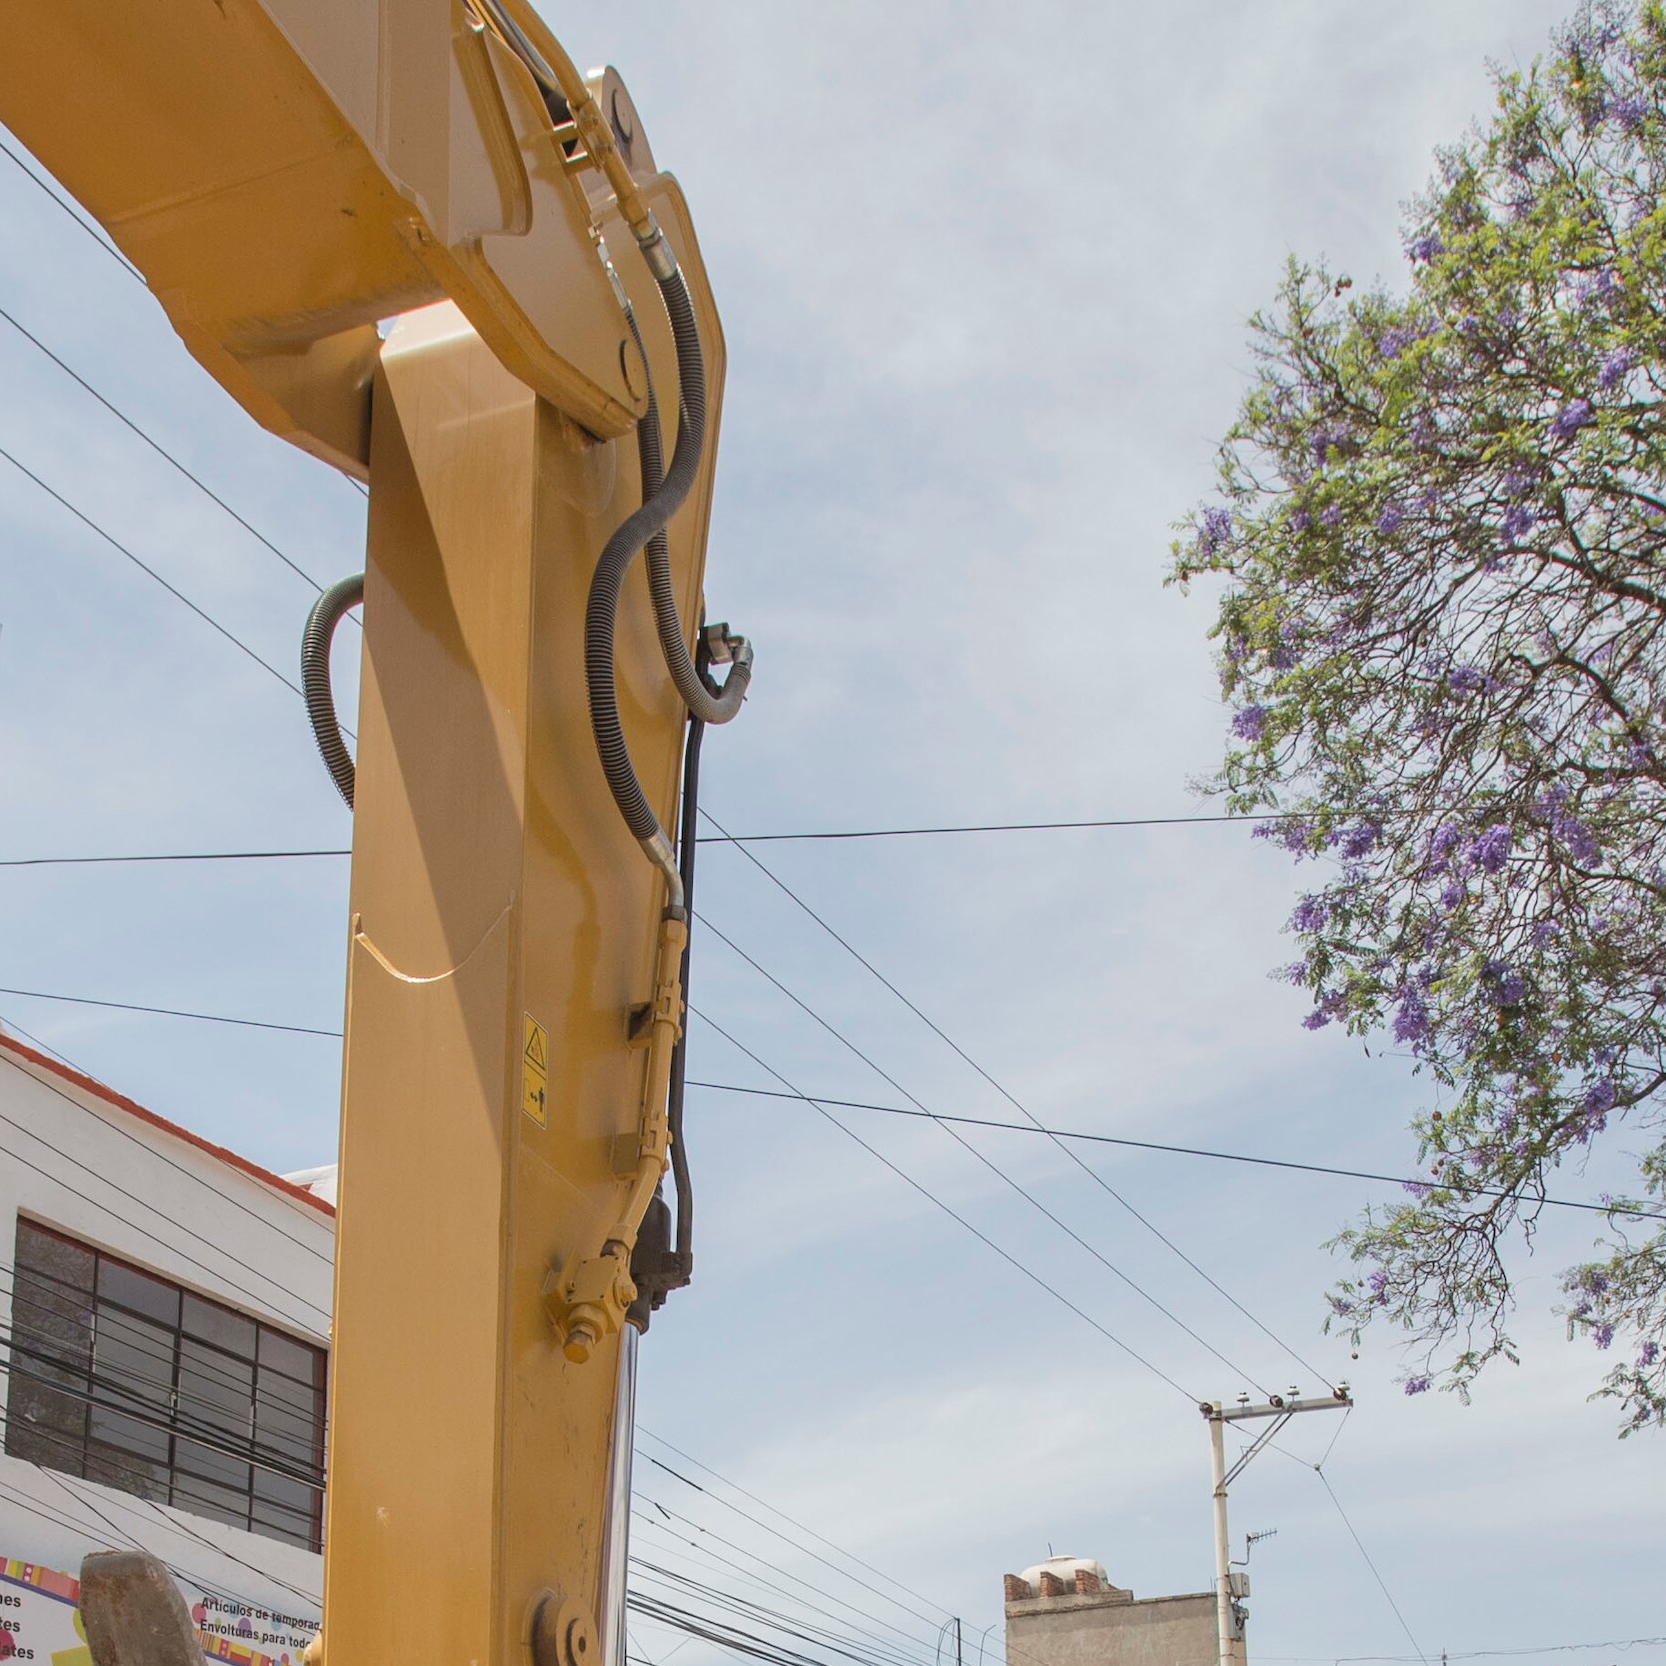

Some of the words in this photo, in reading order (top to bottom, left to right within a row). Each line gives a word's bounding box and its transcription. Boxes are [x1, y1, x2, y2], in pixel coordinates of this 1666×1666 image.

[255, 1609, 272, 1621] de
[200, 1619, 259, 1641] Envolturas
[262, 1632, 286, 1645] para
